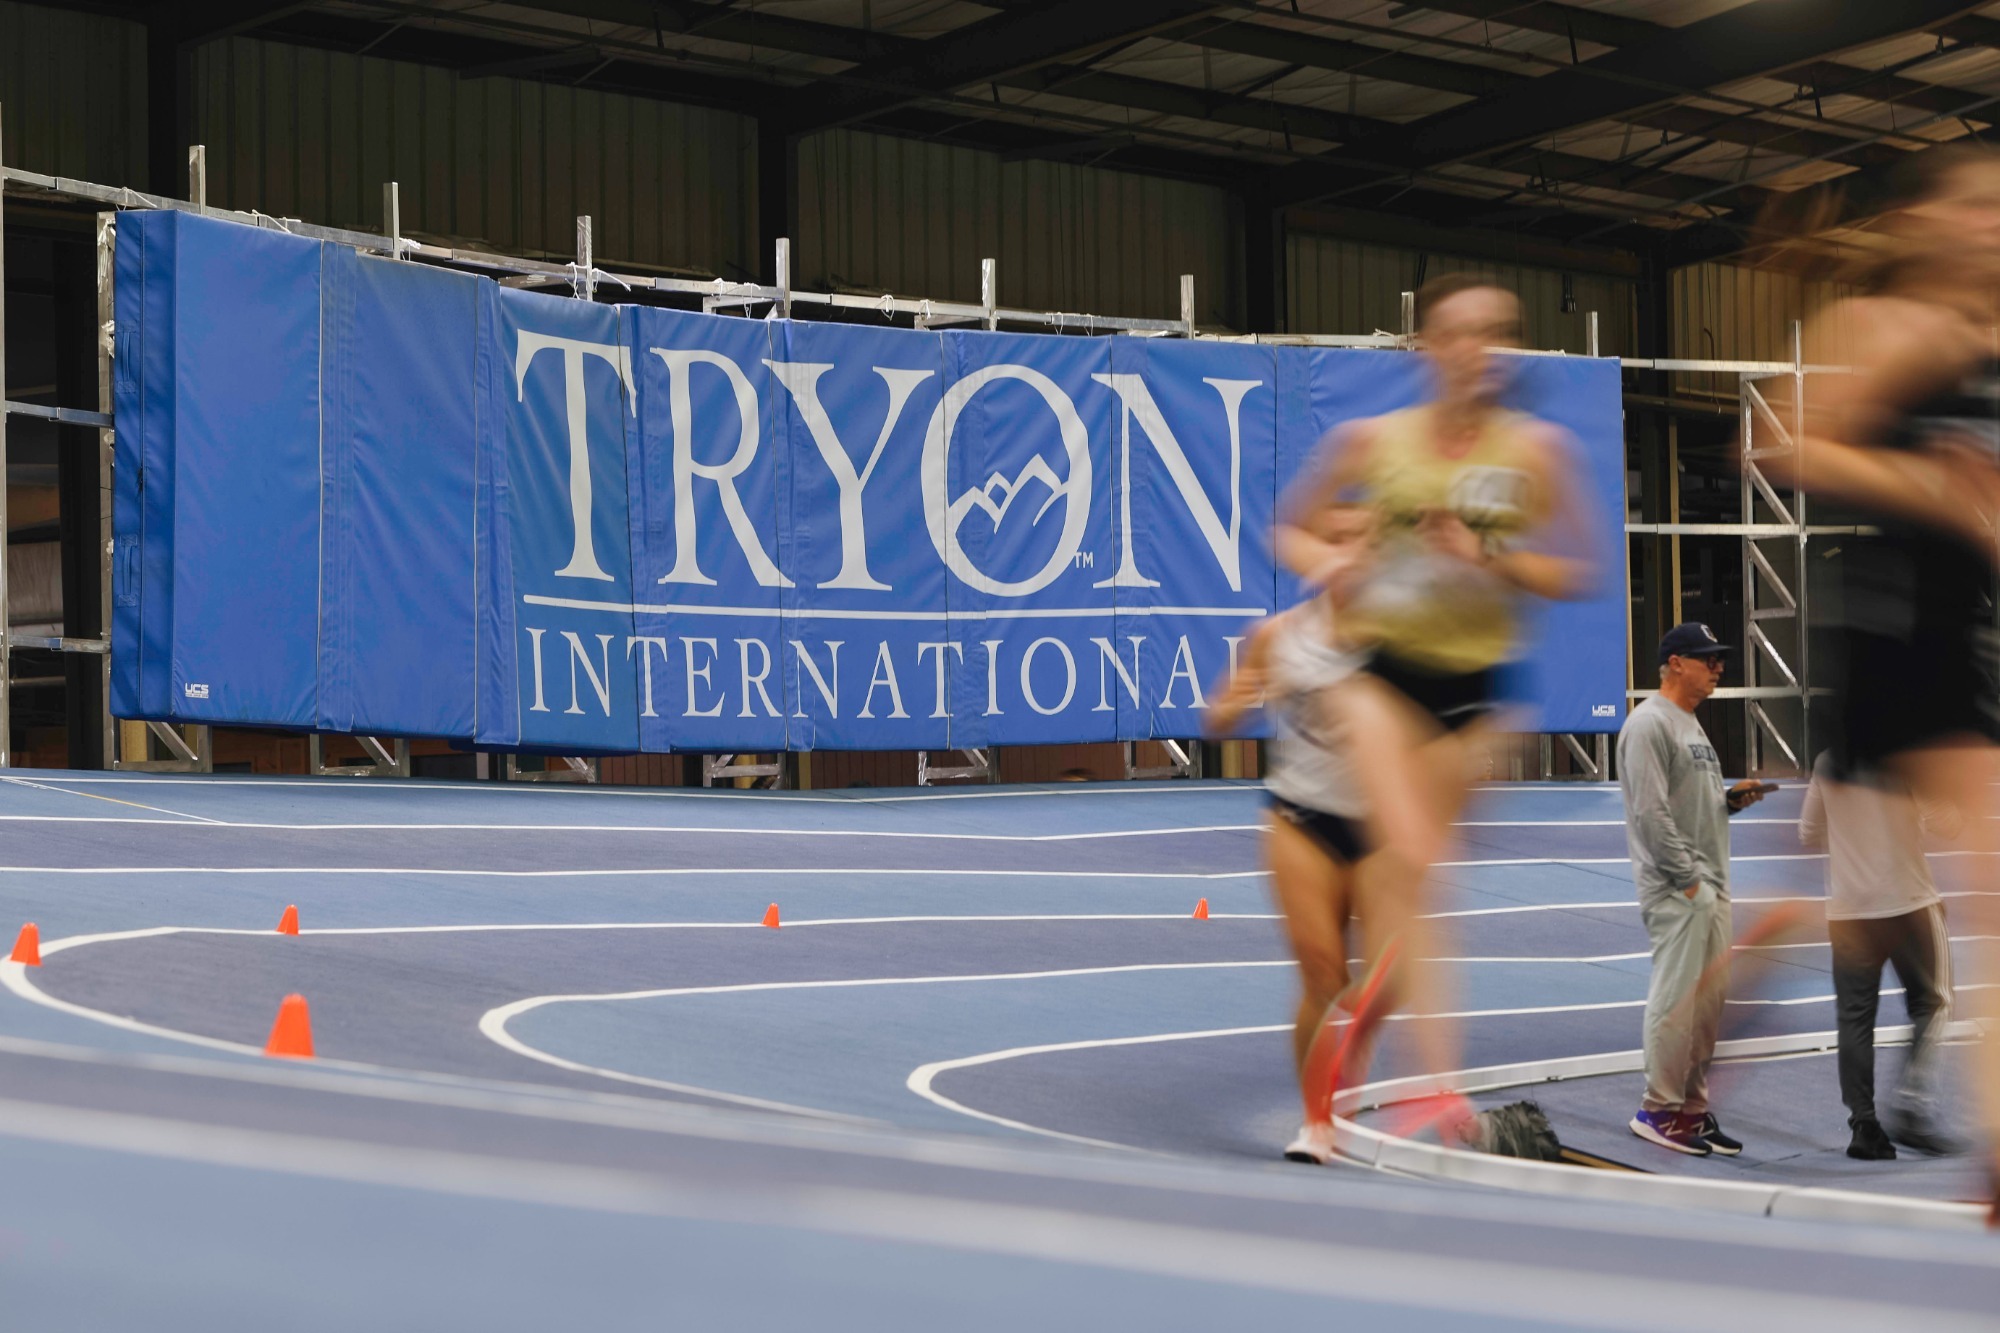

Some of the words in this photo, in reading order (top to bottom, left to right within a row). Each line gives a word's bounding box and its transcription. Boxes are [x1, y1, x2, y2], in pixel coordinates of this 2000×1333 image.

[516, 328, 1263, 597] TRYON
[184, 682, 209, 694] UCS
[1592, 704, 1616, 714] UCS
